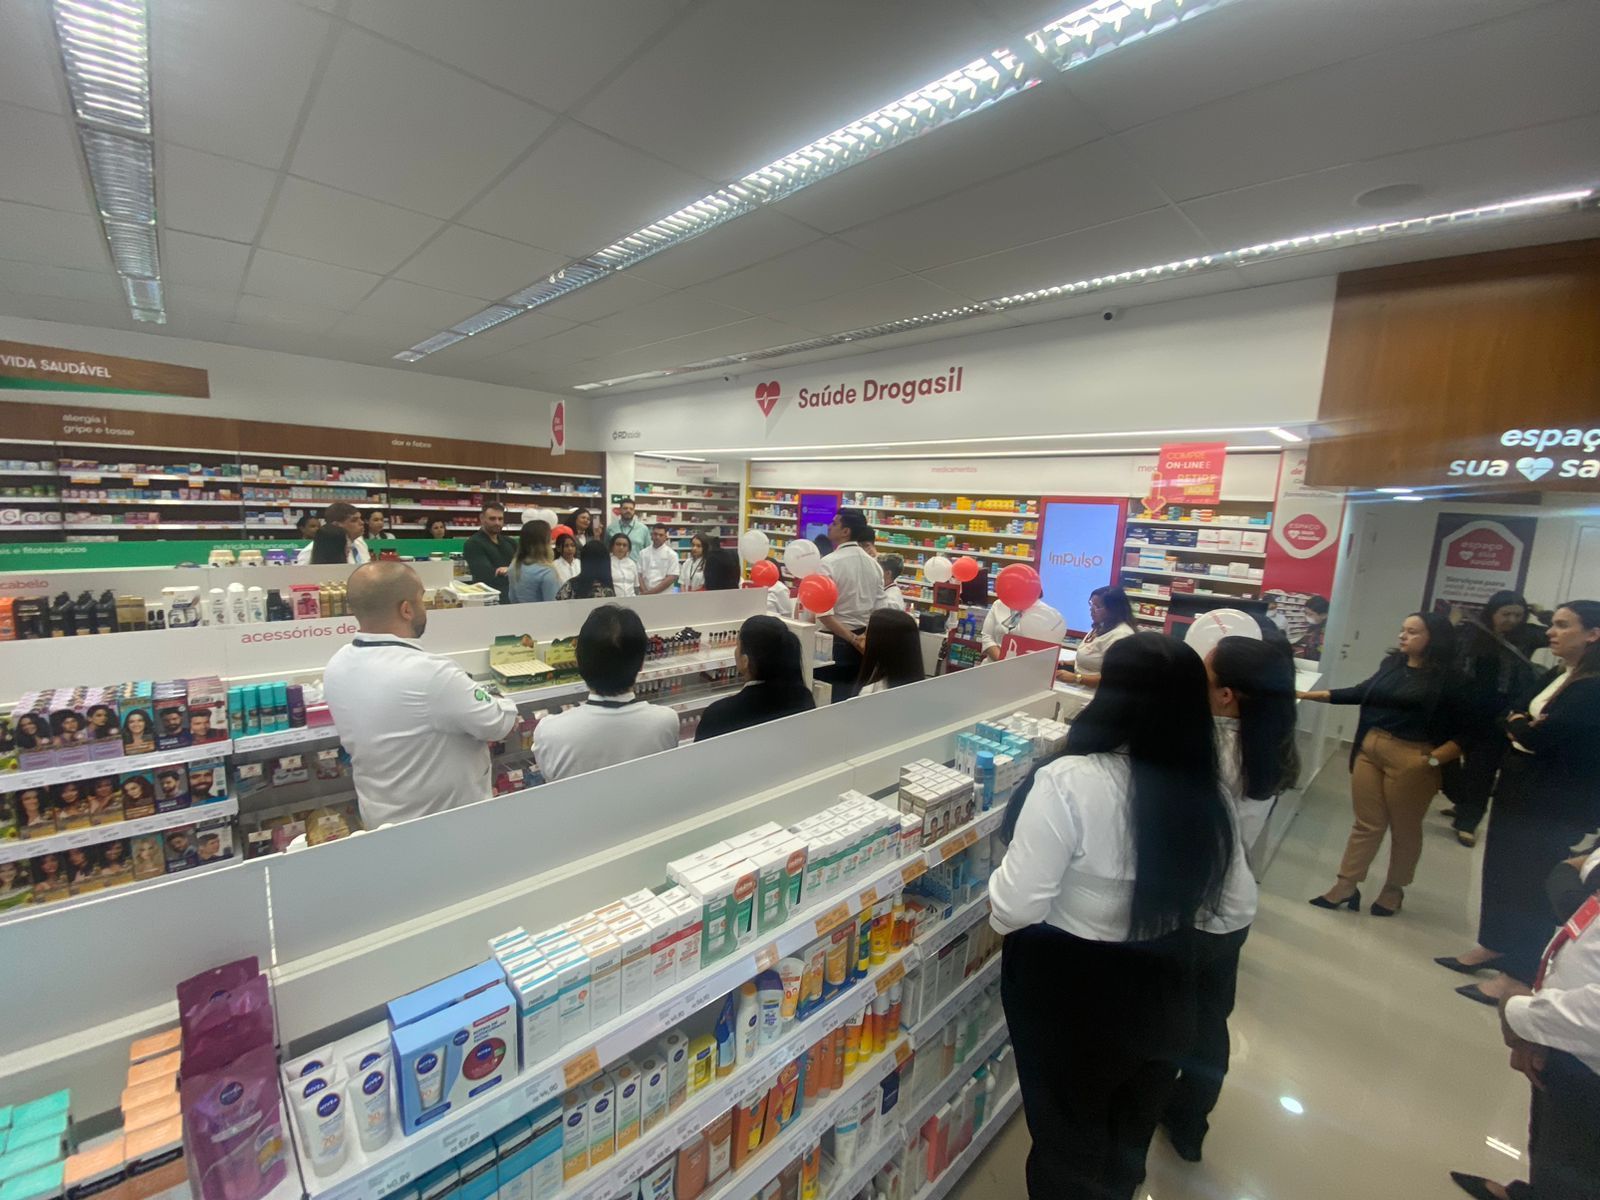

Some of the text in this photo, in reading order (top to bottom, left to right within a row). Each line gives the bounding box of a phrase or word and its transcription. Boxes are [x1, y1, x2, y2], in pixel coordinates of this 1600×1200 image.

[1, 355, 112, 378] VIDA SAUDÁVEL
[799, 366, 963, 408] Saúde Drogasil
[62, 413, 101, 424] alergia
[63, 425, 92, 434] gripe
[105, 426, 135, 436] tosse
[1447, 459, 1510, 477] sua
[241, 623, 357, 644] acessórios de
